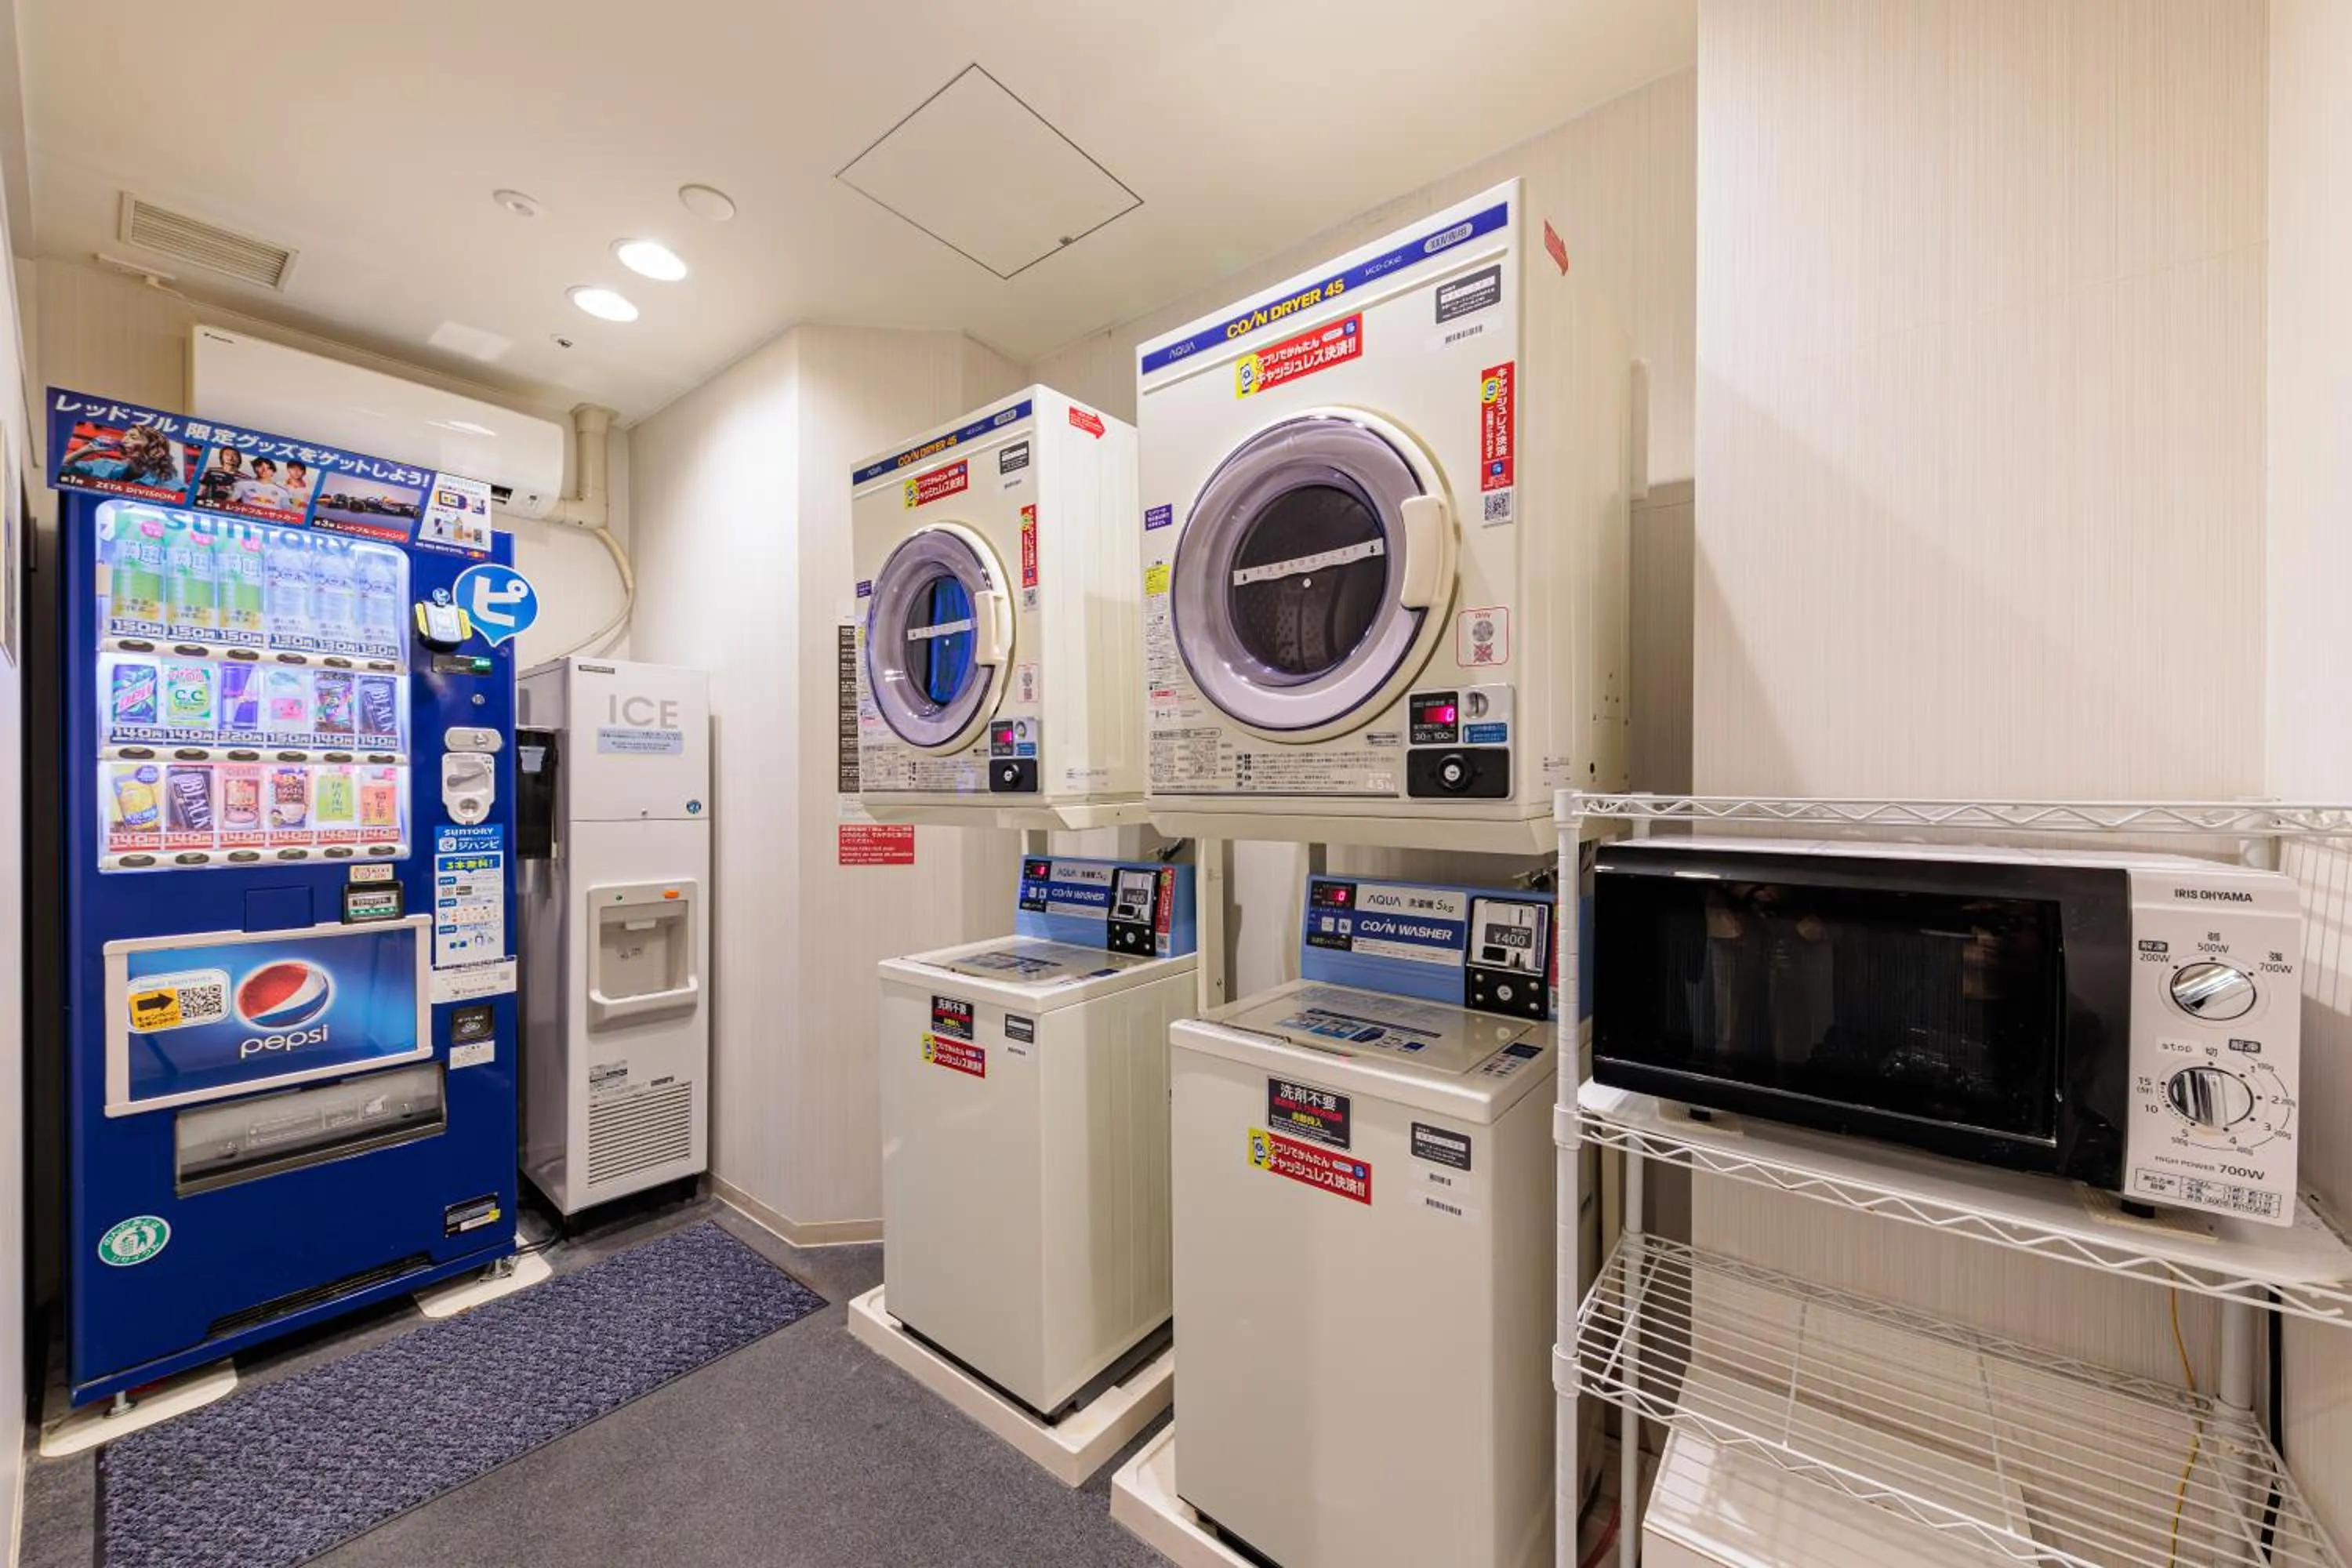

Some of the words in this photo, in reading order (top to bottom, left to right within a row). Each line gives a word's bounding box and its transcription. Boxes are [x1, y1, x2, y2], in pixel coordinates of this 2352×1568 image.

[1270, 288, 1321, 321] DRYER
[1325, 279, 1345, 297] 45
[56, 394, 180, 432] レッドブル
[95, 480, 123, 492] ZETA
[125, 485, 176, 501] DIVISION
[609, 694, 679, 729] ICE
[1445, 708, 1455, 722] 0
[444, 827, 494, 837] SUNTORY
[1367, 894, 1402, 907] AQUA
[2174, 888, 2198, 899] IRIS
[2200, 890, 2253, 902] OHYAMA
[1398, 924, 1453, 941] WASHER
[2197, 942, 2230, 954] 500W
[2139, 953, 2170, 964] 200W
[2259, 962, 2293, 975] 700W
[240, 1023, 328, 1058] pepsi
[2161, 1042, 2193, 1054] stop
[2138, 1076, 2151, 1086] 15
[1280, 1083, 1337, 1112] 洗剤不要
[2144, 1104, 2158, 1114] 10
[2263, 1122, 2271, 1131] 3
[2182, 1129, 2189, 1138] 5
[2229, 1136, 2238, 1145] 4
[2180, 1160, 2216, 1171] POWER
[2219, 1163, 2266, 1180] 700W
